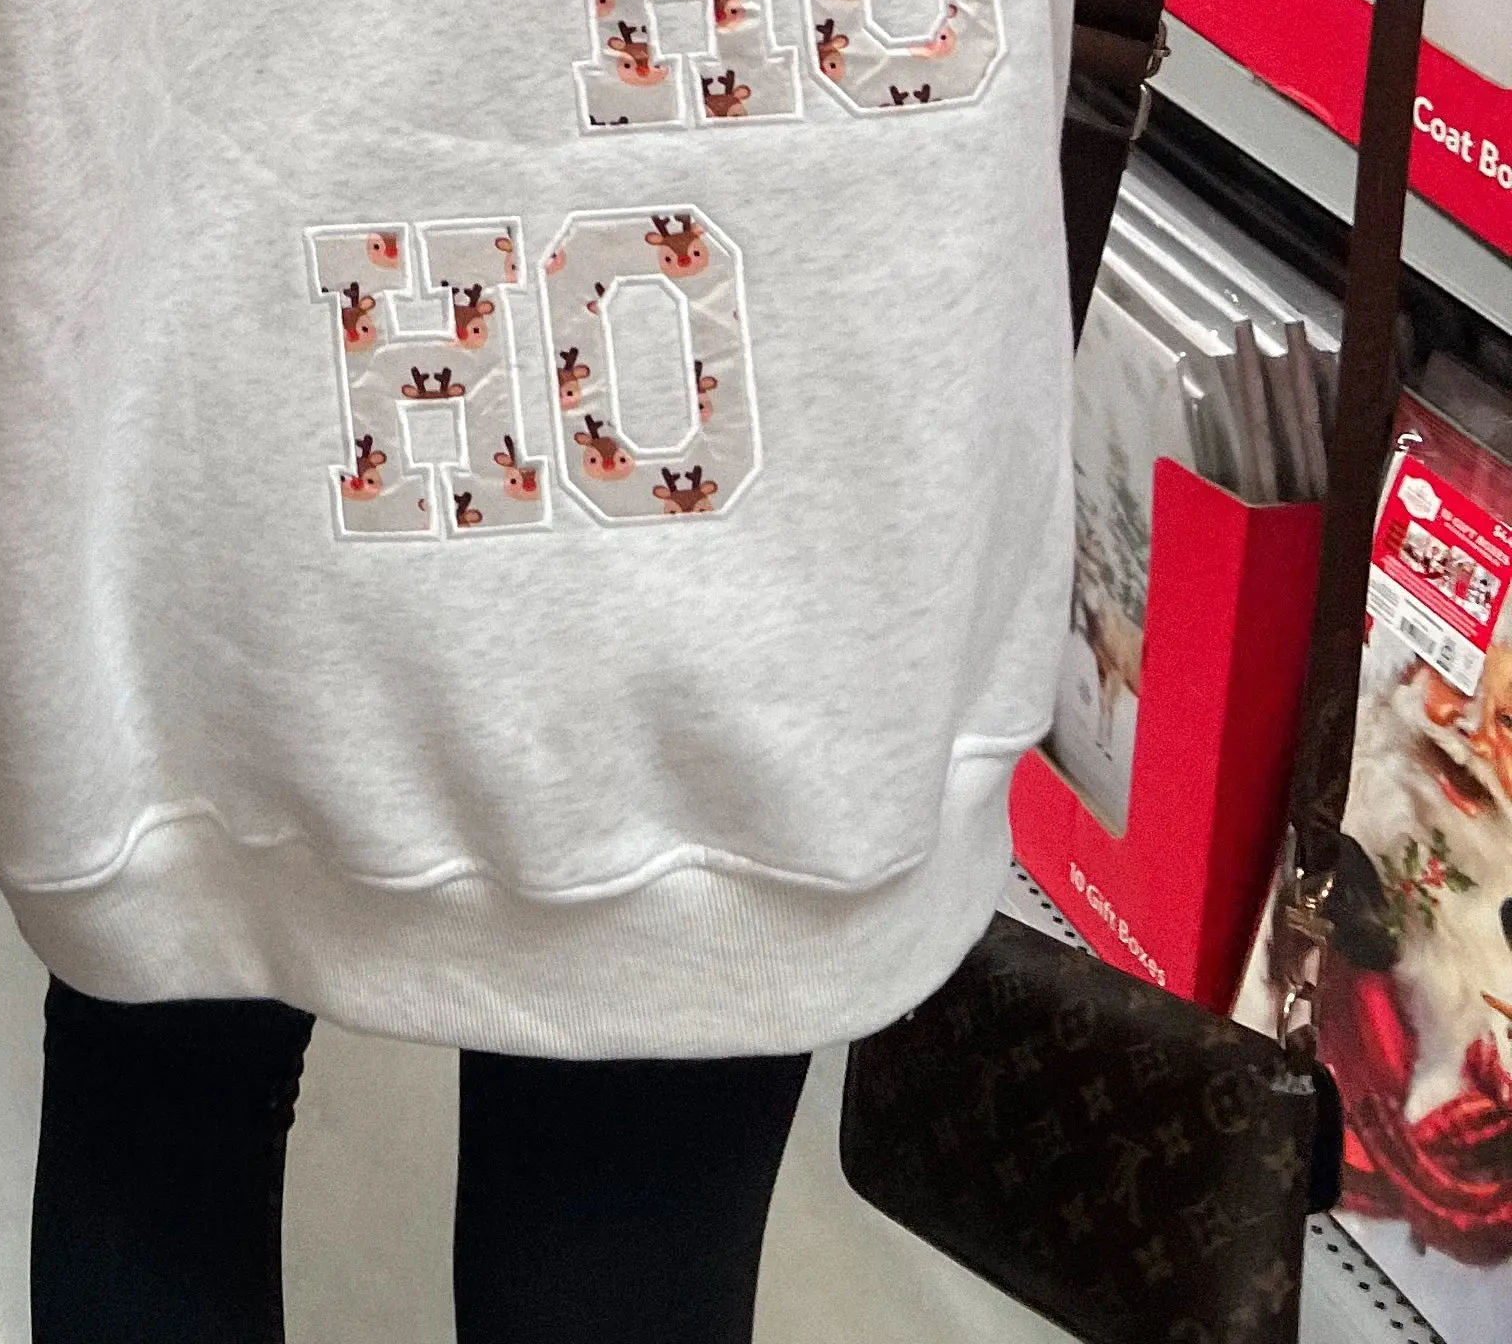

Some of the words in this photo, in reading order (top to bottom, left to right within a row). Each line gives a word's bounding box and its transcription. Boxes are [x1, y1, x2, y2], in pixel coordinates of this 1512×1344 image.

[1412, 96, 1475, 163] Coat
[305, 204, 764, 540] HO
[1086, 884, 1117, 932] Gift
[1118, 918, 1166, 987] Boxes
